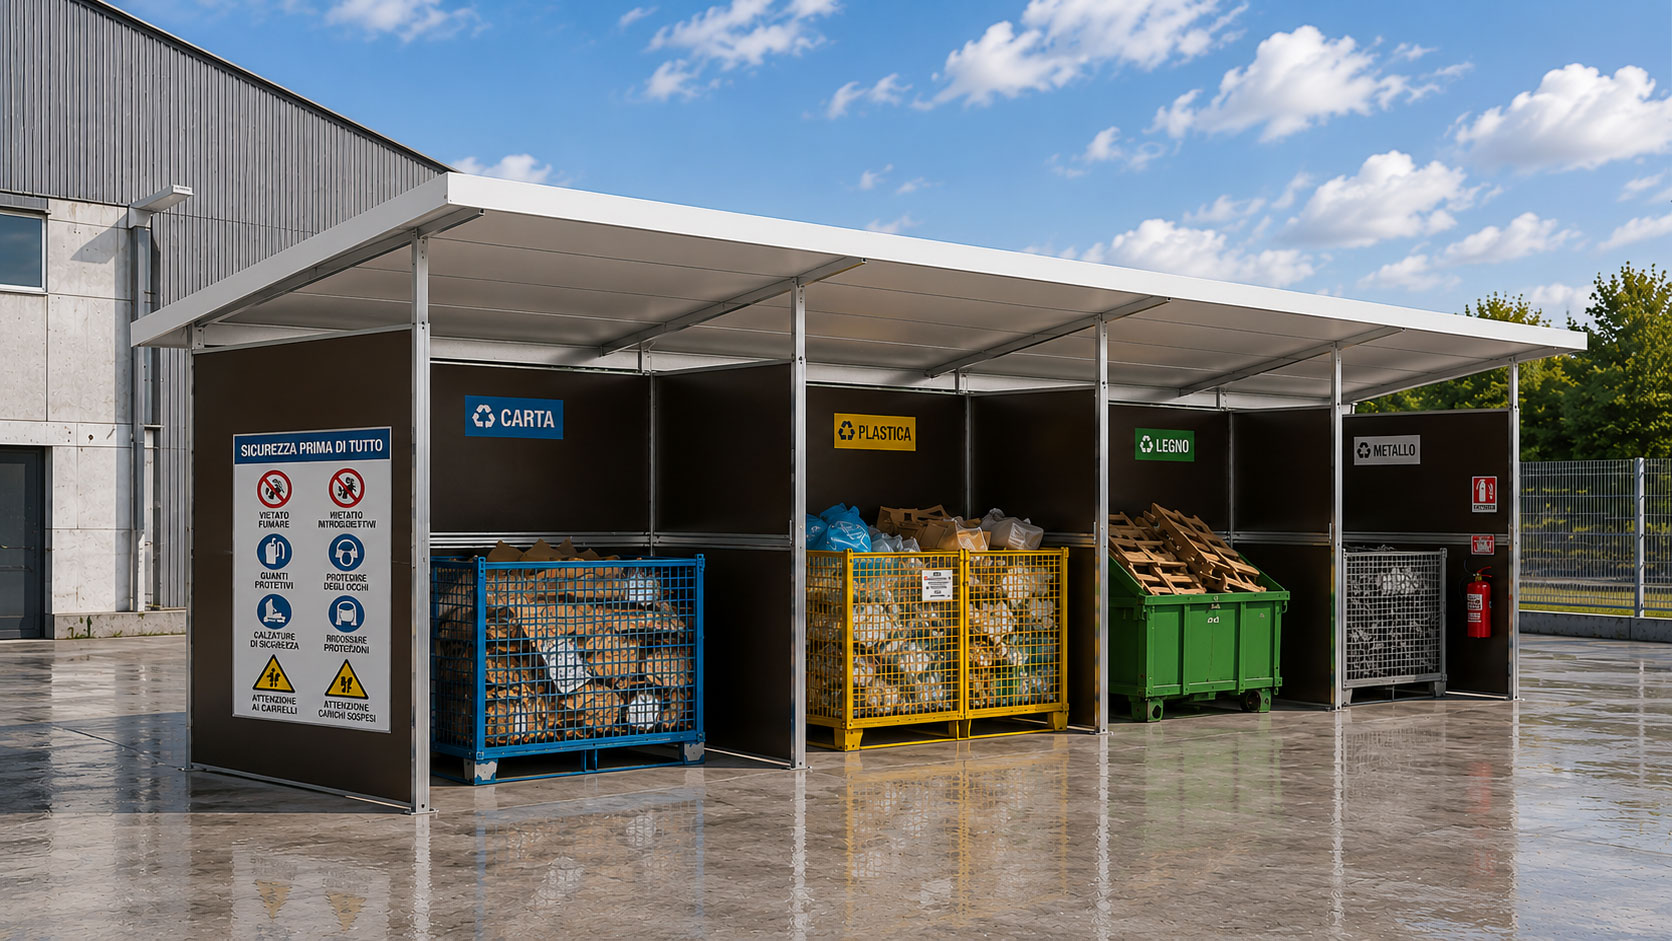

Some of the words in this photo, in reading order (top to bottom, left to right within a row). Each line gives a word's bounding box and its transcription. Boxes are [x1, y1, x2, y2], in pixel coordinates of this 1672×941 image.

[500, 408, 555, 428] CARTA
[858, 424, 912, 442] PLASTICA
[241, 442, 297, 457] SICUREZZA
[299, 440, 333, 454] PRIMA
[336, 440, 346, 453] DI
[348, 438, 383, 452] TUTTO
[1155, 438, 1190, 453] LEGNO
[1373, 443, 1416, 457] METALLO
[259, 511, 290, 519] VIETATO
[258, 520, 290, 528] FUMARE
[260, 572, 289, 580] GUANTI
[323, 582, 344, 590] DEGLI
[346, 583, 369, 591] OCCHI
[253, 631, 296, 641] CALZATURE
[250, 640, 258, 648] DI
[252, 694, 297, 705] ATTENZIONE
[252, 703, 260, 711] AI
[261, 704, 298, 715] CARRELLI
[347, 712, 376, 723] SOSPESI
